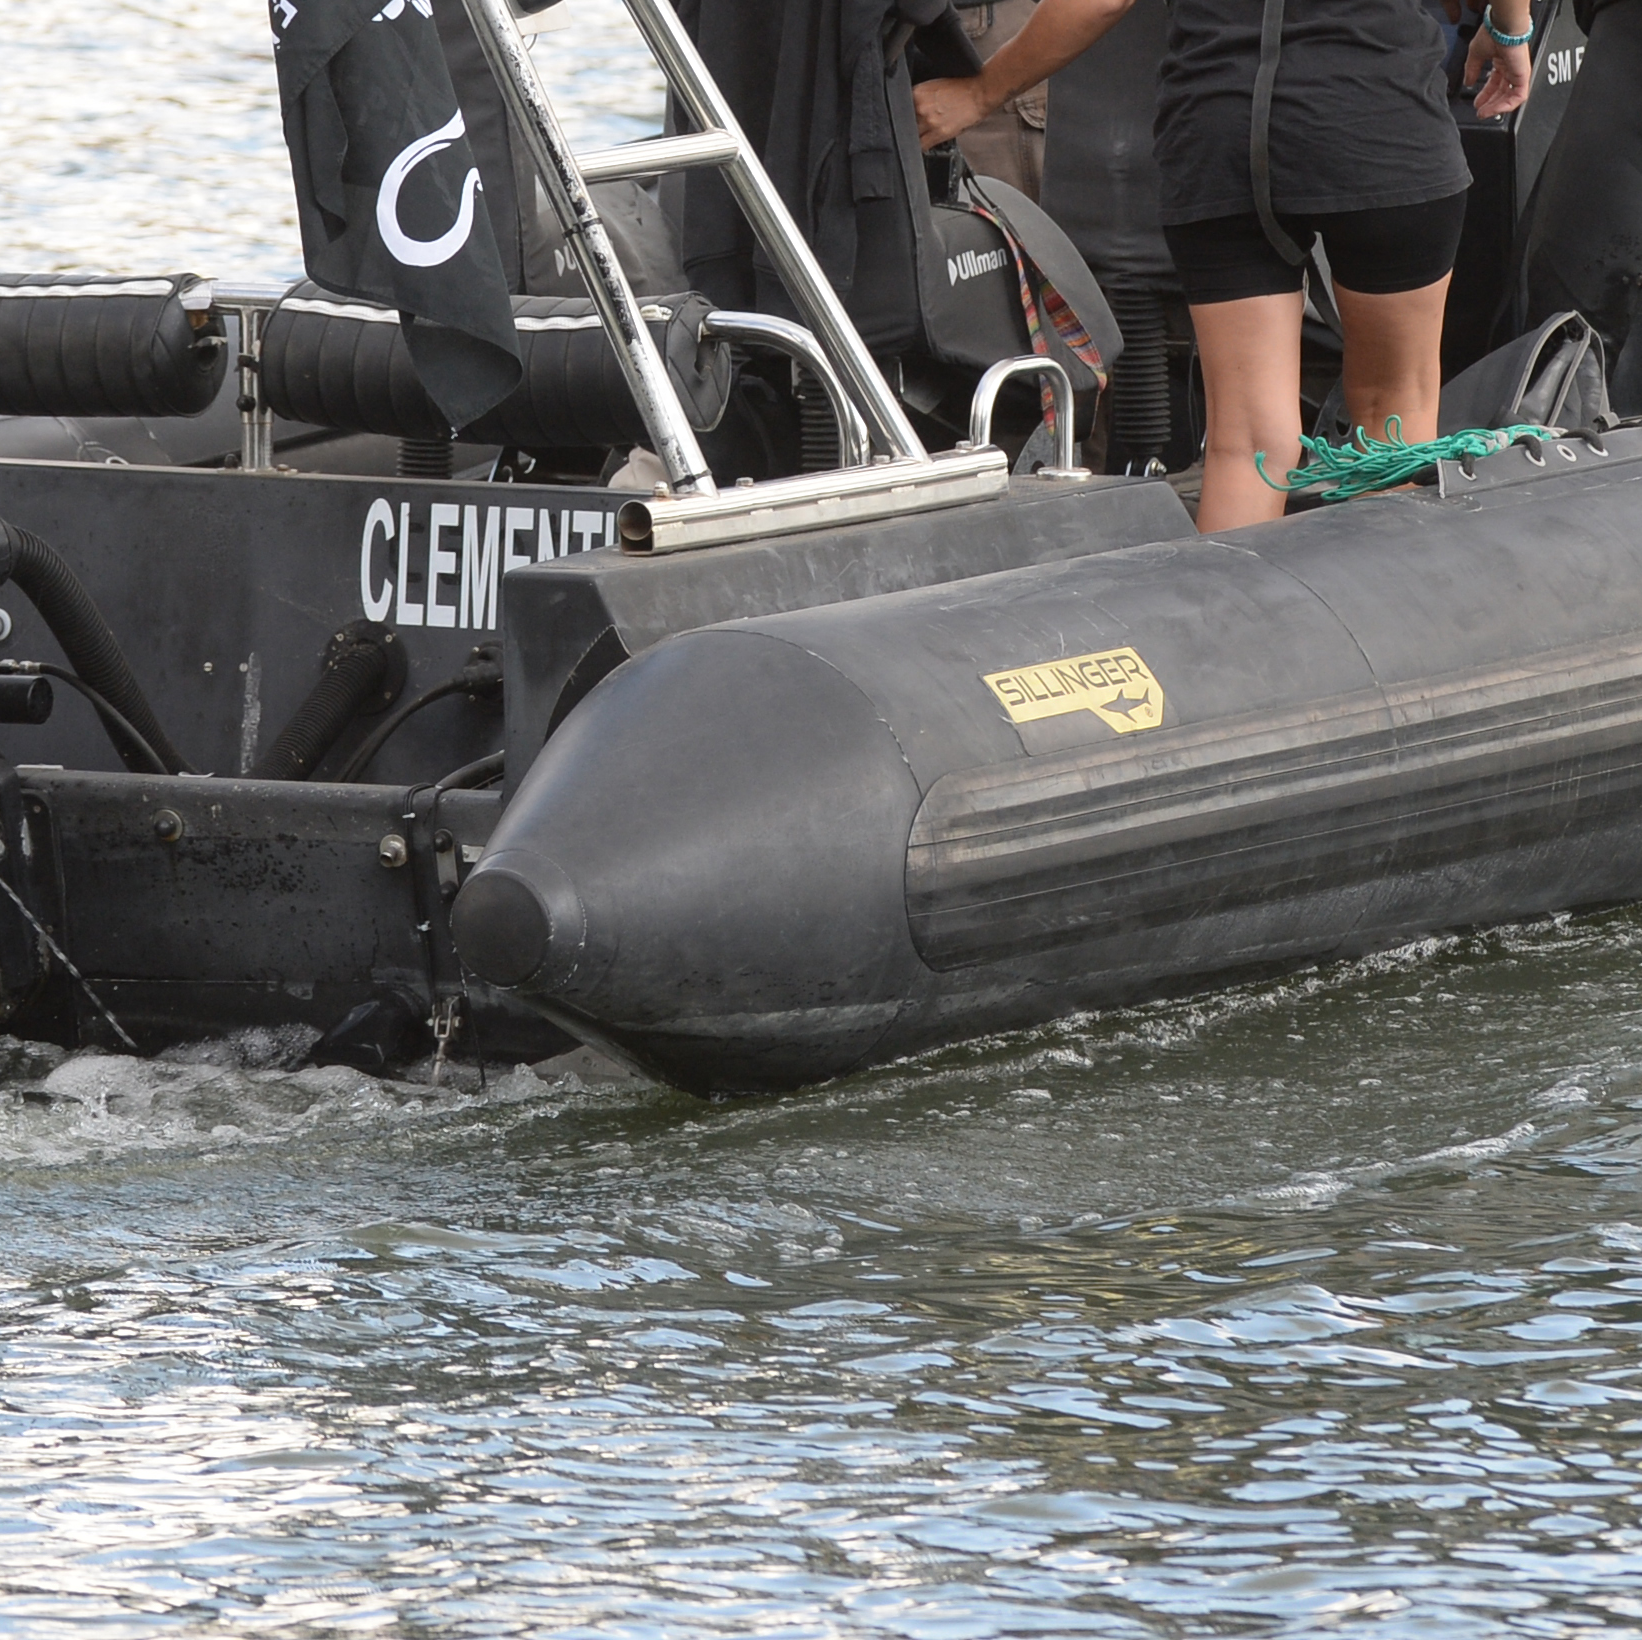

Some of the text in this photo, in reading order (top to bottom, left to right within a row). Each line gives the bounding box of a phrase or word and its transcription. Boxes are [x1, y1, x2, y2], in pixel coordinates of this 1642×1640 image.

[1547, 52, 1572, 85] SM
[955, 247, 1008, 281] Ullman
[994, 654, 1149, 707] SILLINGER
